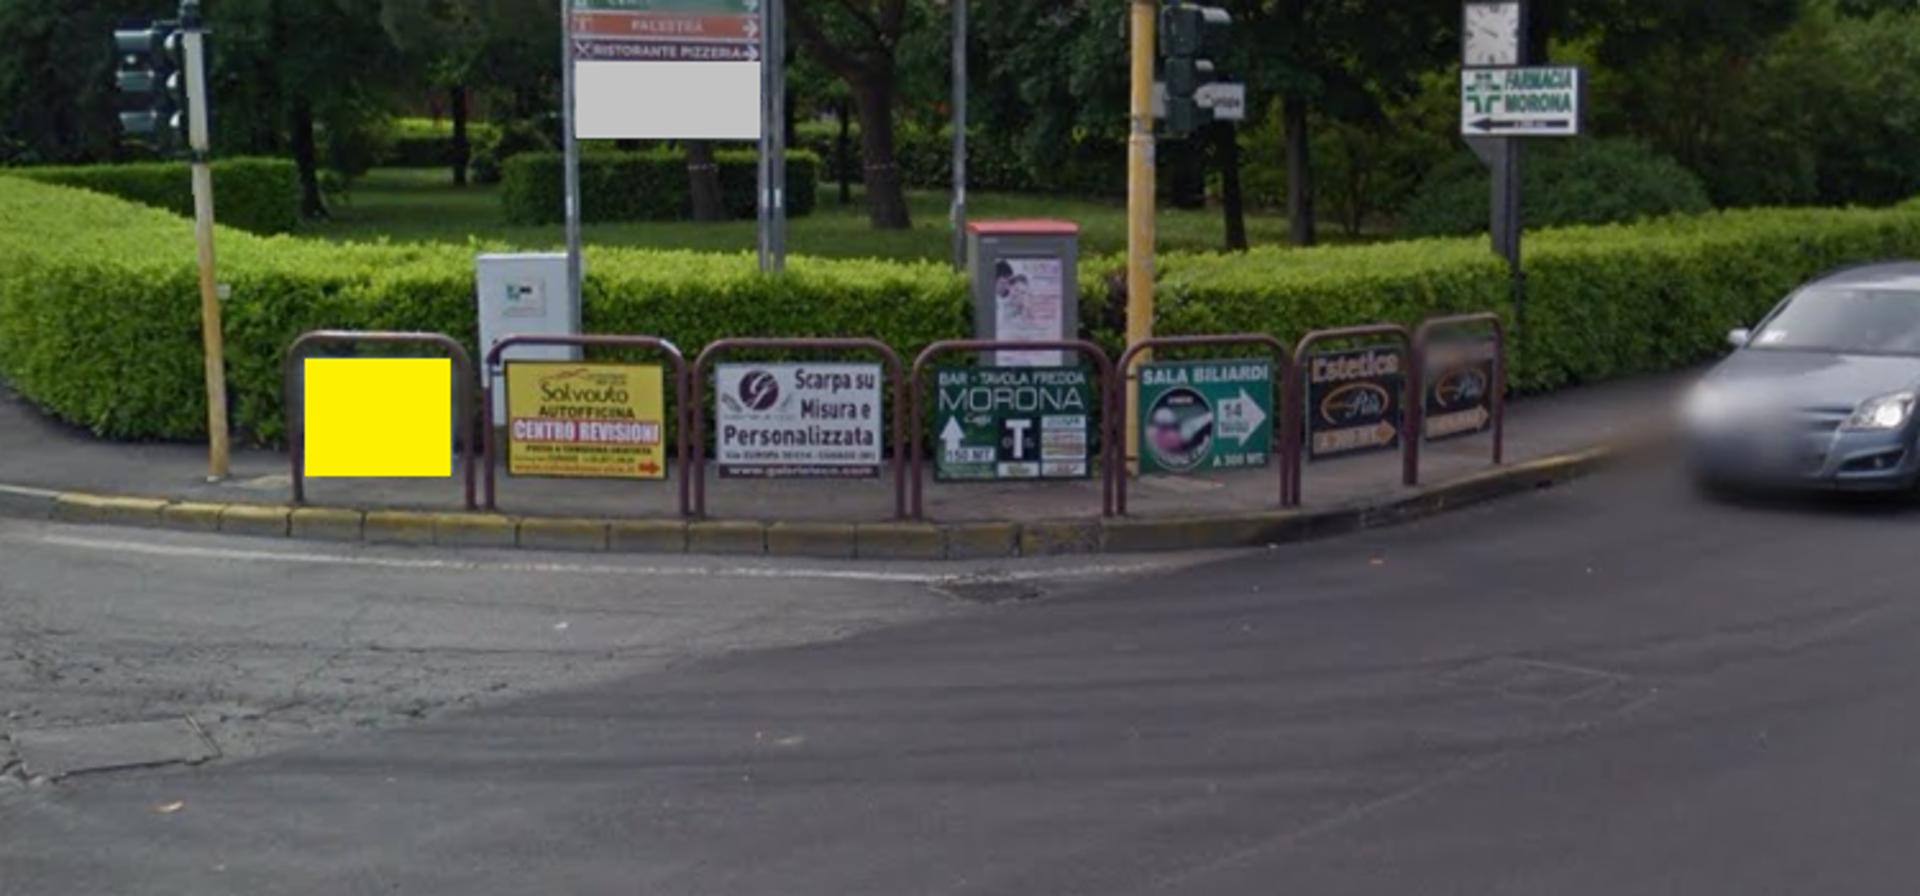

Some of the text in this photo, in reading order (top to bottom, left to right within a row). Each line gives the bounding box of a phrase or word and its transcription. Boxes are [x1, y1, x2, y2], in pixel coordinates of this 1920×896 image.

[631, 18, 703, 33] PALESTRA
[593, 44, 741, 59] RISTORANTE PIZZERIA
[1506, 69, 1572, 89] FARMACIA
[1505, 93, 1572, 112] MORONA
[1143, 364, 1268, 384] SALA BILIARDI
[1313, 352, 1399, 382] Estetica
[795, 368, 875, 393] Scarpa su
[938, 372, 968, 385] BAR
[979, 371, 1029, 385] TAVOLA
[1032, 371, 1086, 385] FREDDA
[938, 386, 1084, 411] MORONA
[538, 405, 636, 419] AUTOFFICINA
[801, 398, 871, 420] Misura e
[513, 420, 660, 442] CENTRO REVISIONI
[723, 424, 874, 446] Personalizzata
